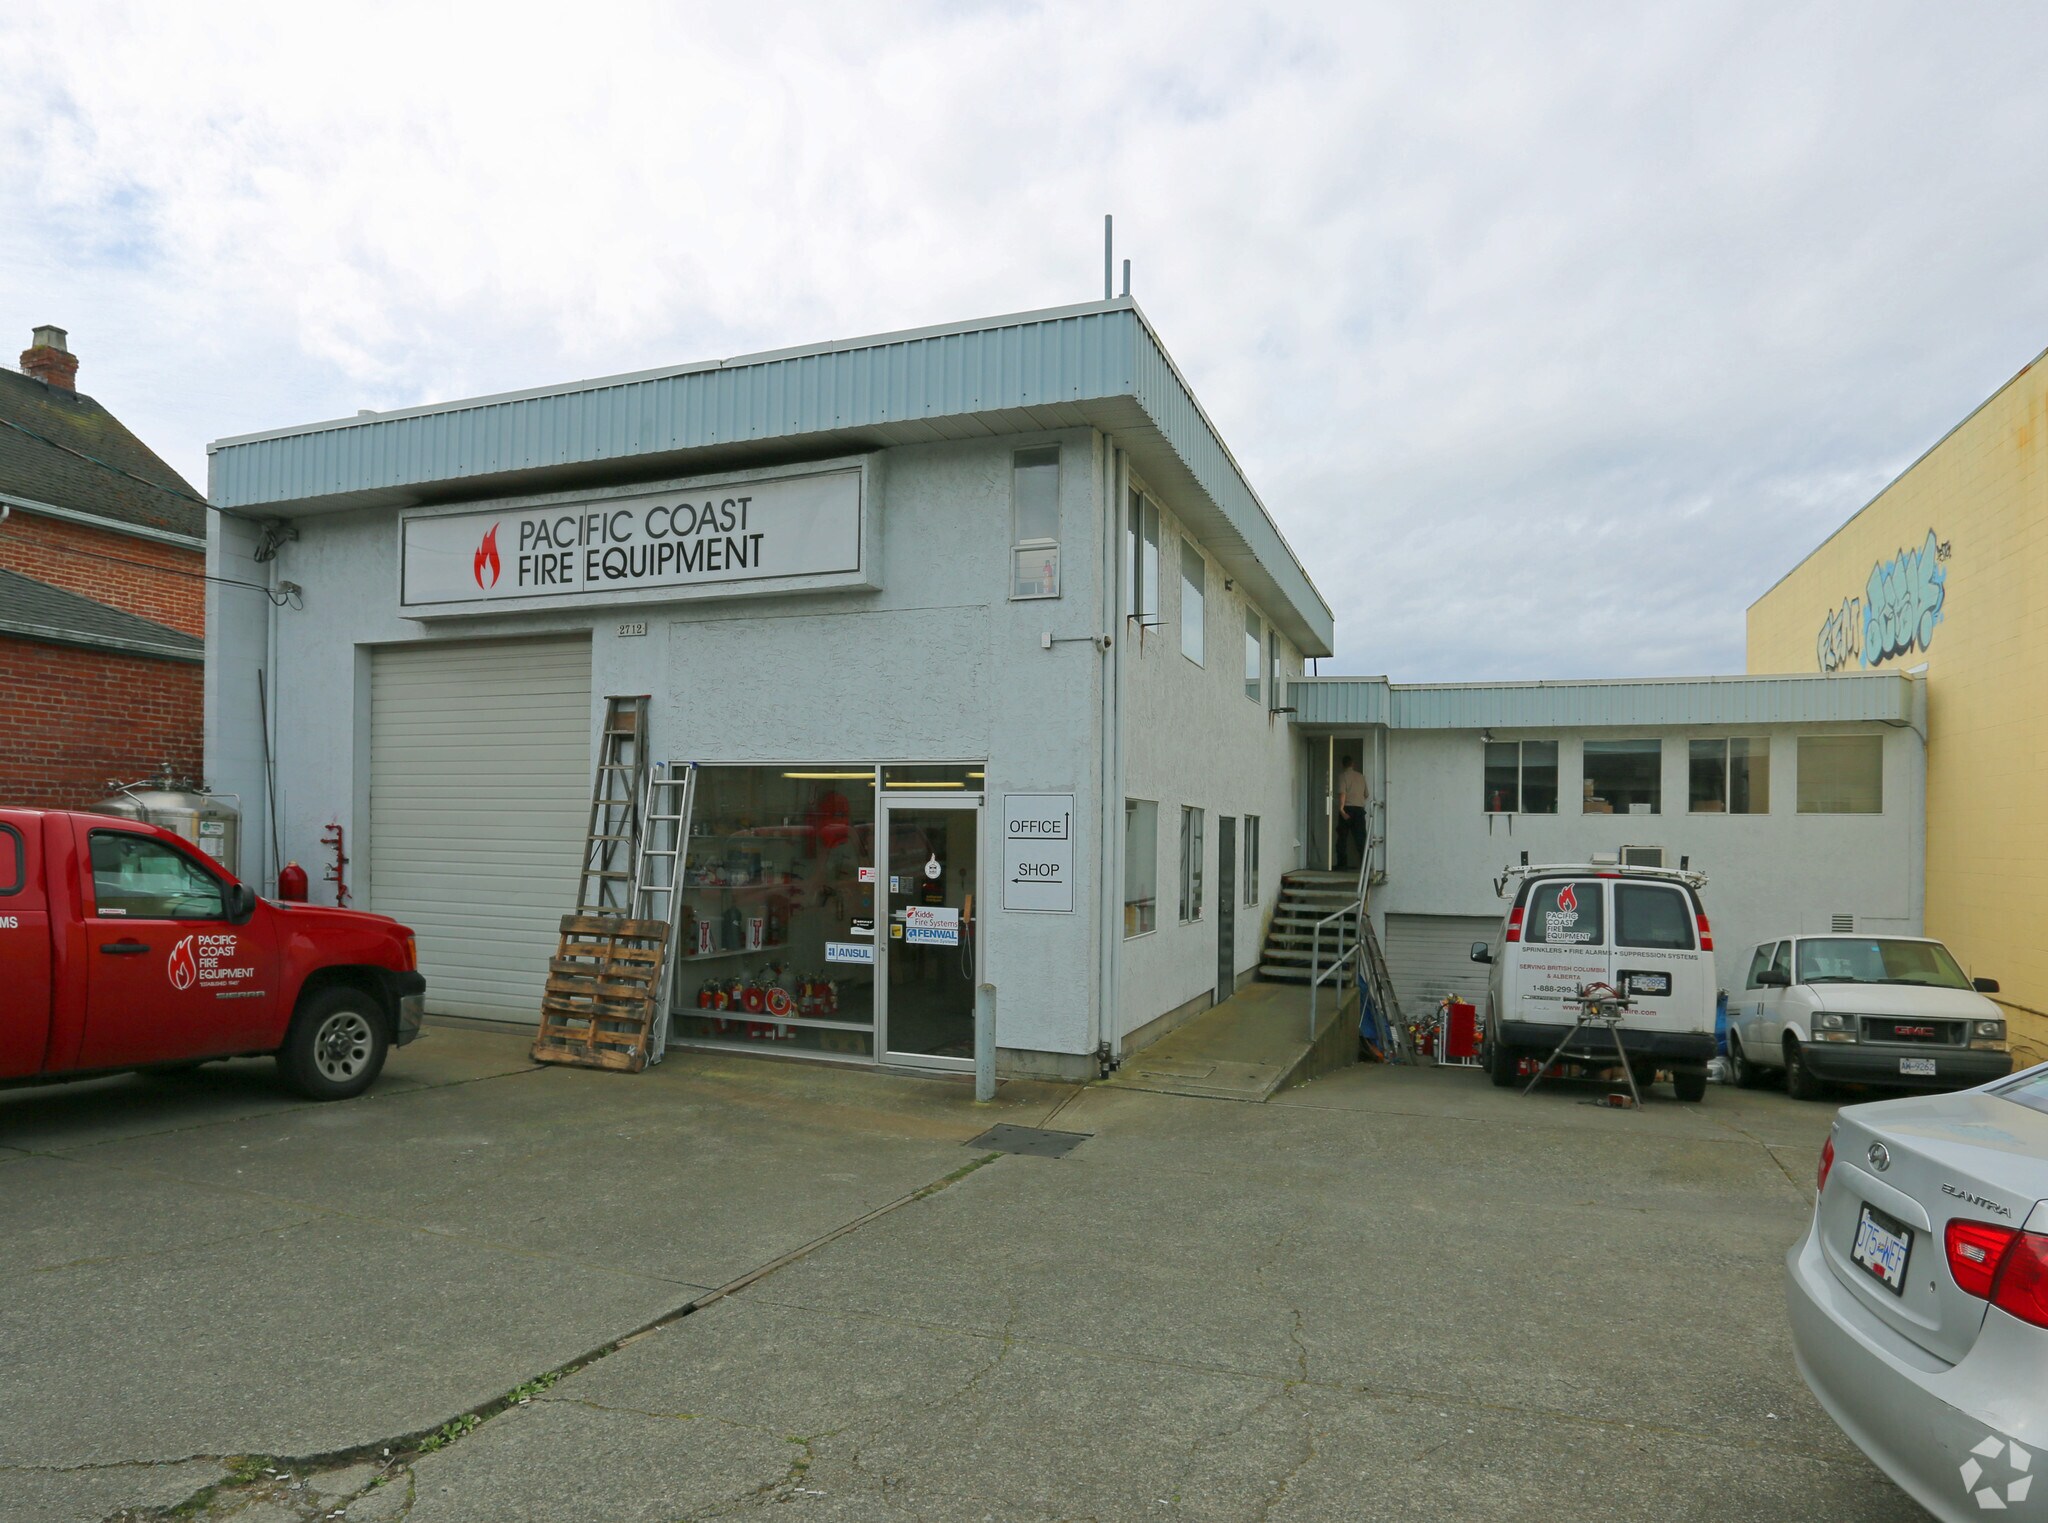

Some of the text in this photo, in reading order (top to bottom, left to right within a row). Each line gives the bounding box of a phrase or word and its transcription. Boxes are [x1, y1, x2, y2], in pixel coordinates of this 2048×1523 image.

[519, 497, 752, 551] PACIFIC COAST
[518, 533, 764, 586] FIRE EQUIPMENT
[619, 624, 642, 635] 2712
[1009, 820, 1061, 833] OFFICE
[1018, 863, 1060, 876] SHOP
[914, 911, 934, 919] Kidde
[1547, 912, 1578, 920] PACIFIC
[930, 919, 958, 928] Systems
[918, 929, 957, 940] FENWAL
[1547, 932, 1590, 940] EQUIPMENT
[198, 935, 237, 945] PACIFIC
[199, 946, 235, 957] COAST
[838, 948, 871, 958] ANSUL
[1667, 952, 1698, 960] SYSTEMS
[199, 958, 218, 968] FIRE
[199, 968, 254, 980] EQUIPMENT
[1895, 1026, 1935, 1036] GMC
[1942, 1183, 2012, 1218] ELANTRA
